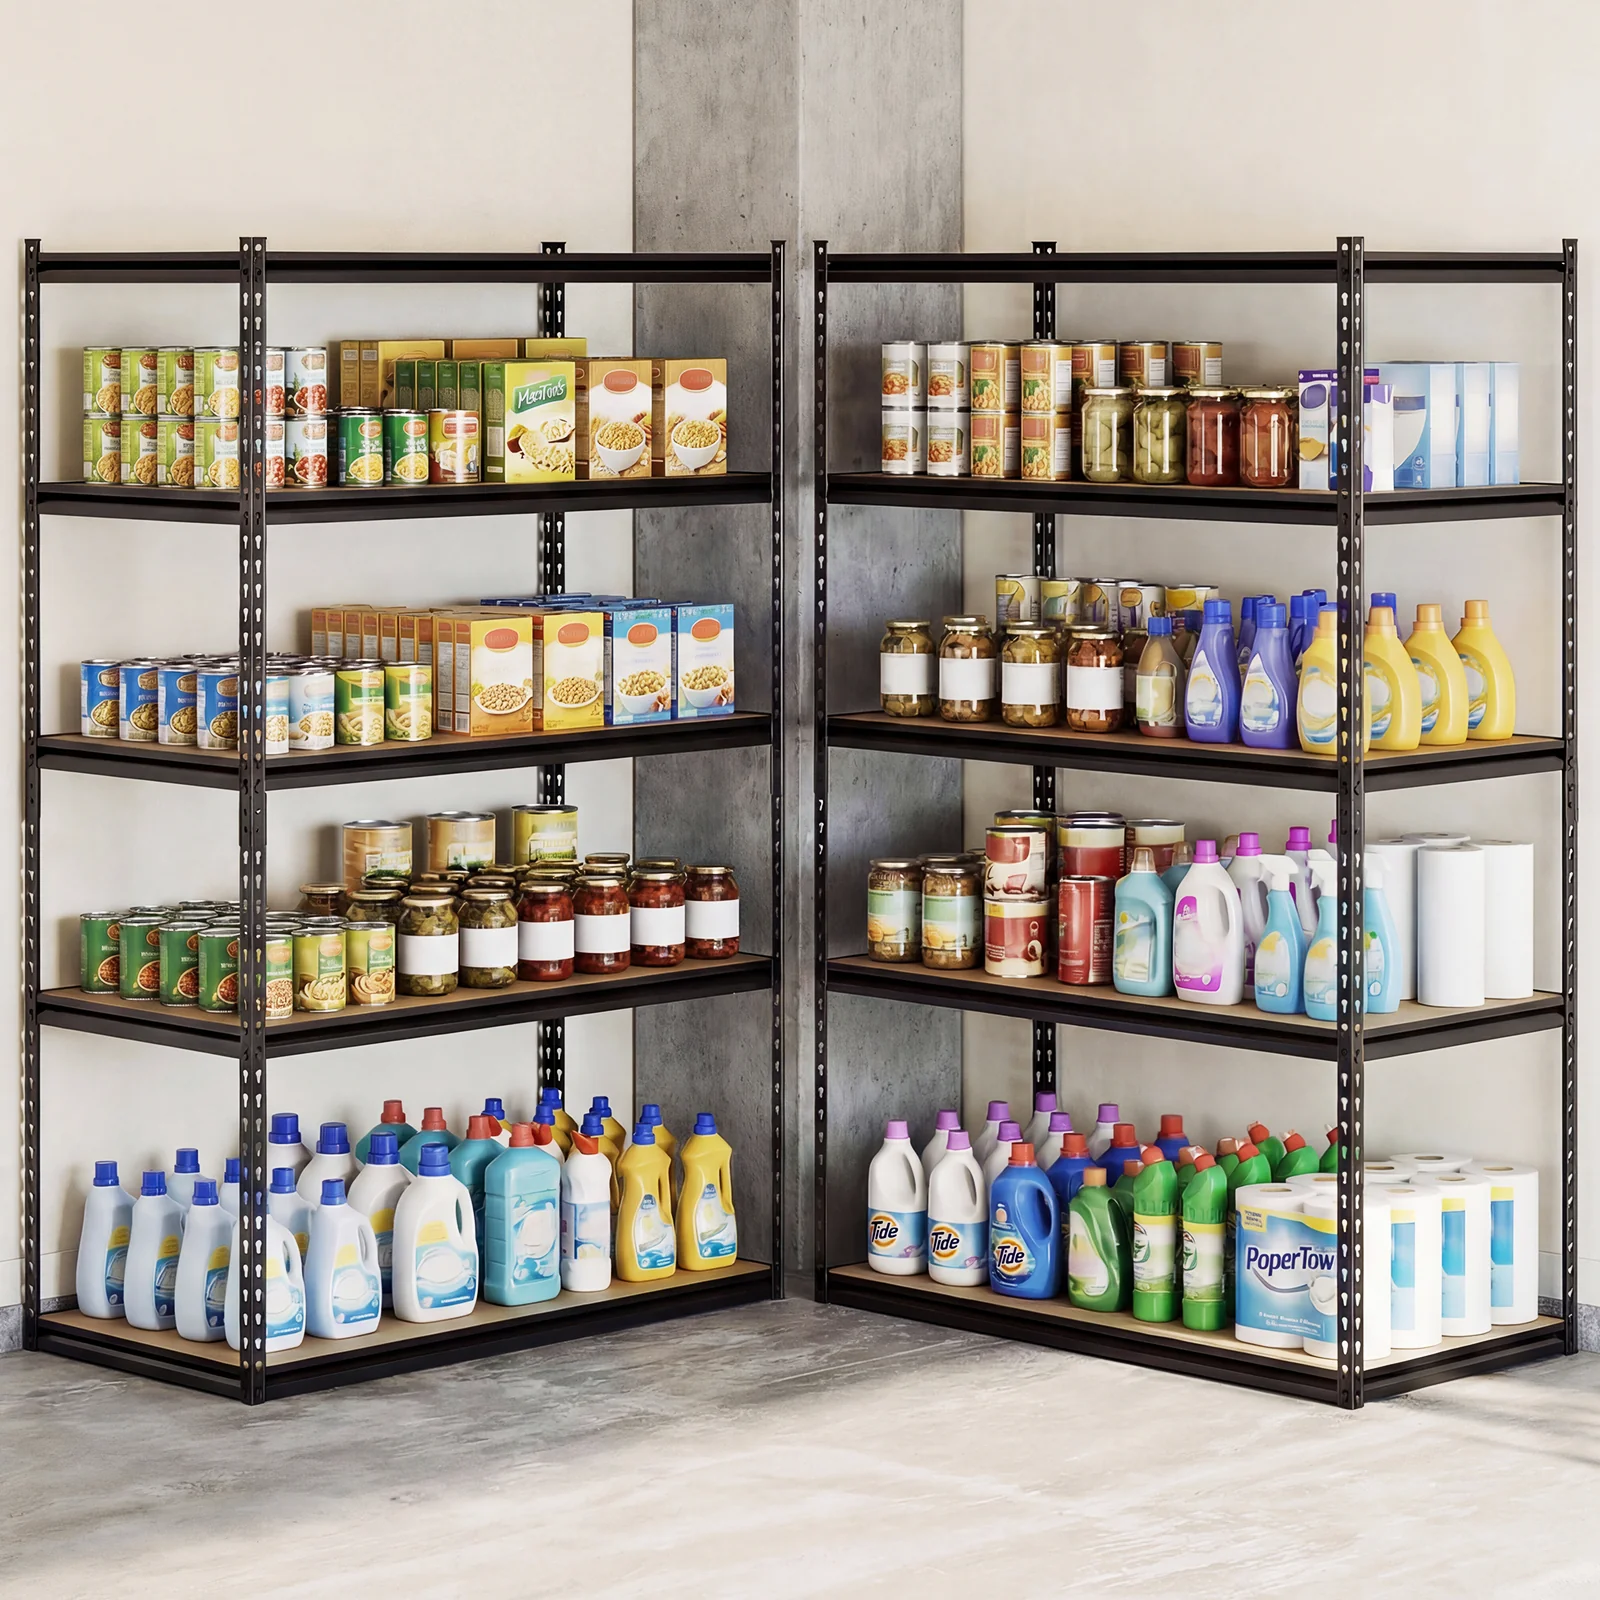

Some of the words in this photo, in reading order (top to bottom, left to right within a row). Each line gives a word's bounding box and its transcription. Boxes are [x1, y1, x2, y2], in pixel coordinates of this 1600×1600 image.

[871, 1221, 898, 1242] Tide
[931, 1231, 960, 1253] Tide
[997, 1245, 1025, 1268] Tide
[1246, 1246, 1335, 1277] PoperTow
